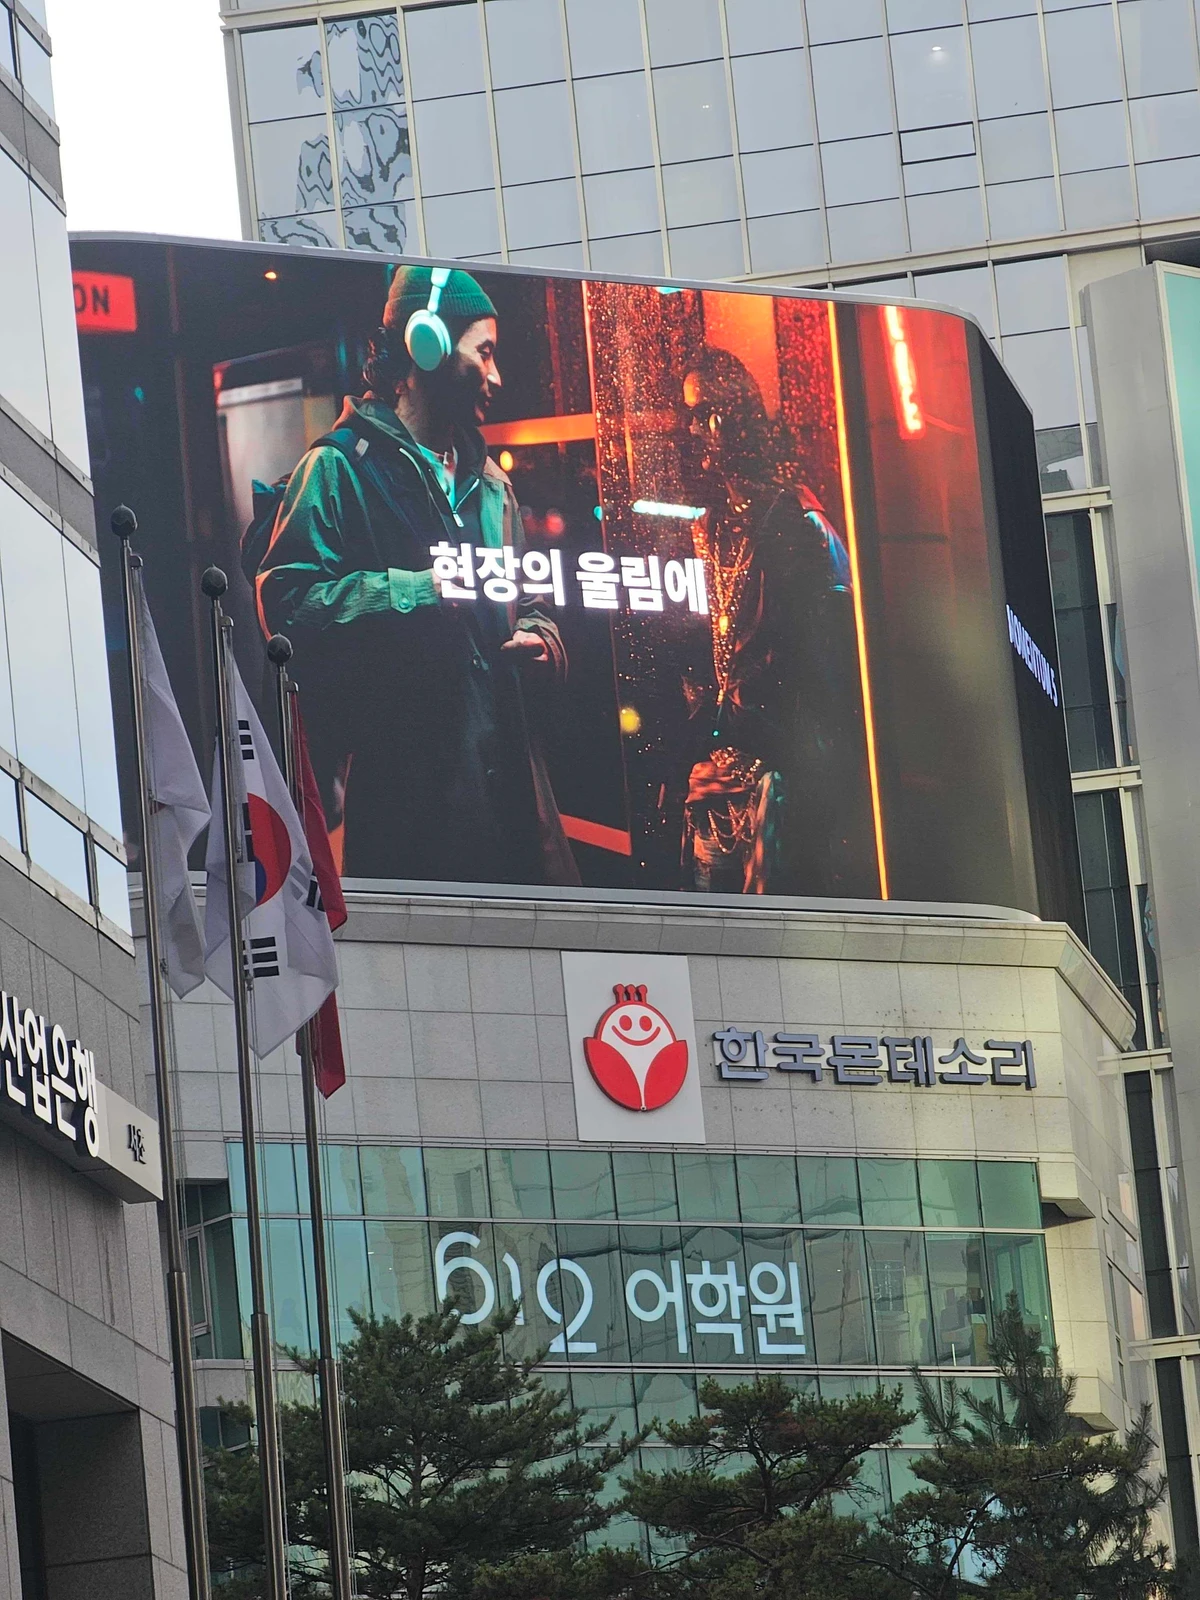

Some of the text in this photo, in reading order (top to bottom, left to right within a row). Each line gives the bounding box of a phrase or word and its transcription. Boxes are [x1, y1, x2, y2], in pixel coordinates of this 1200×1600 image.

[429, 541, 710, 615] 현장의 울림에
[0, 990, 100, 1158] 산업은행
[711, 1026, 1037, 1091] 한국몬테소리
[434, 1231, 806, 1356] 612 어학원
